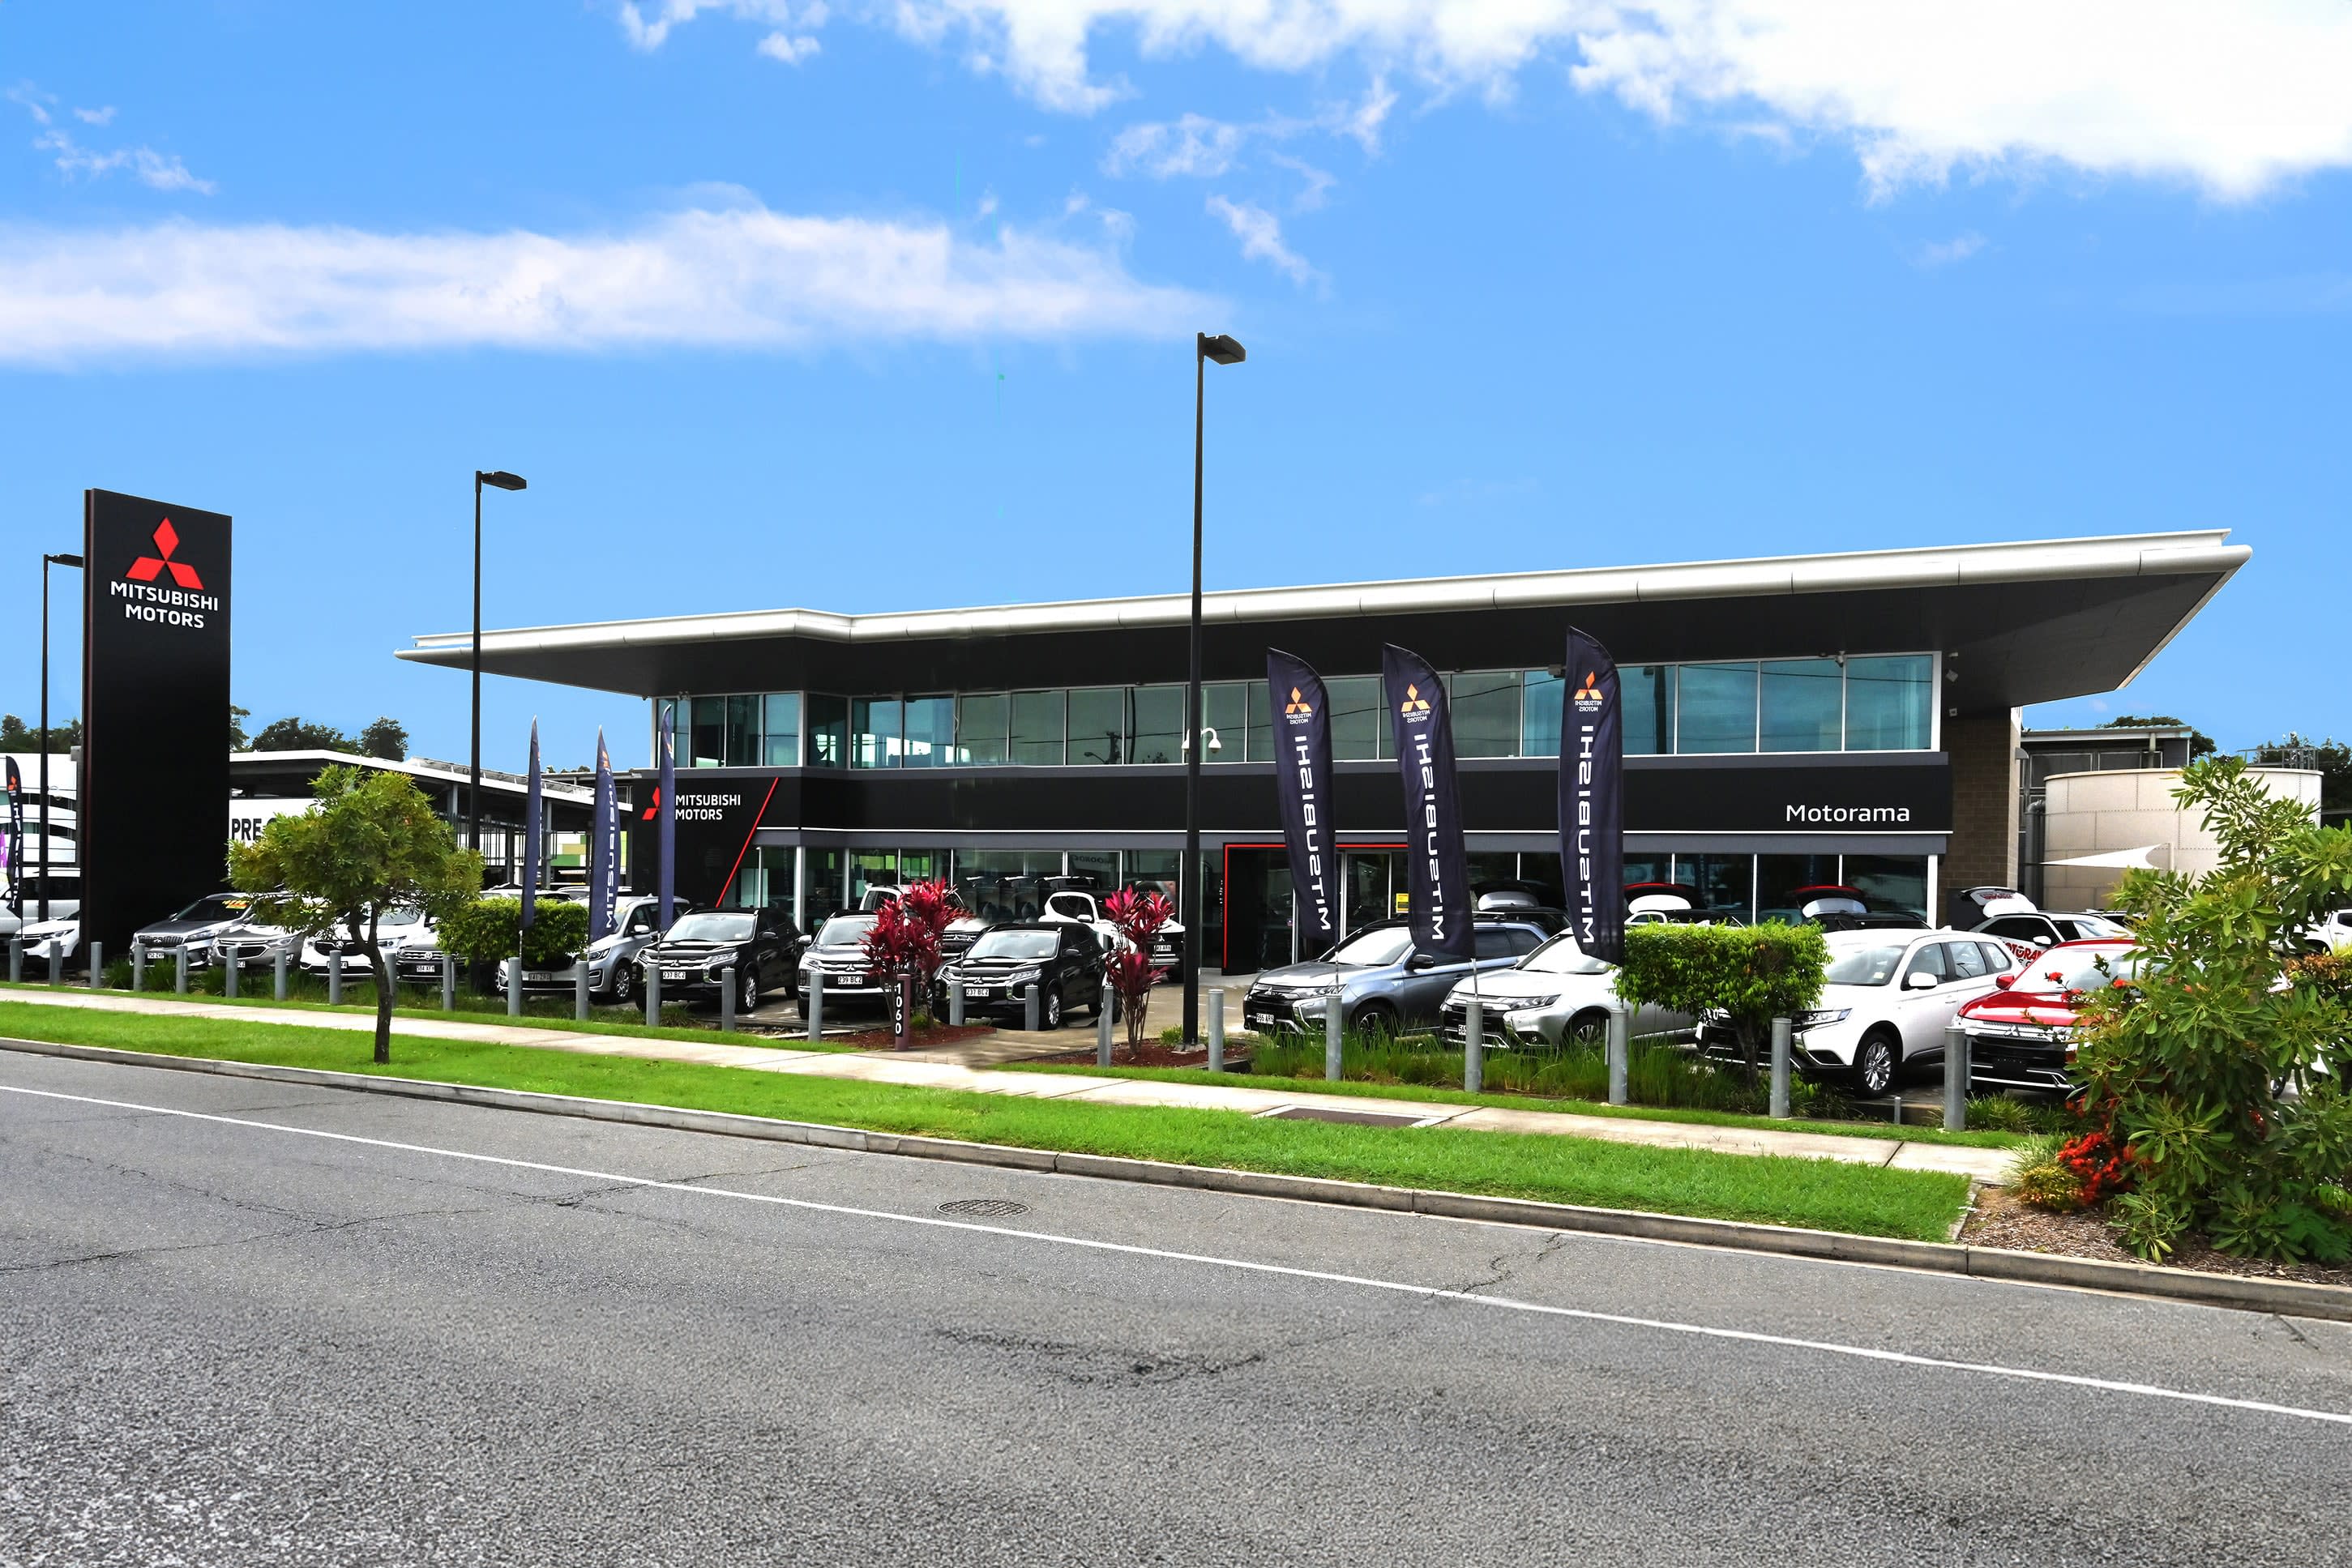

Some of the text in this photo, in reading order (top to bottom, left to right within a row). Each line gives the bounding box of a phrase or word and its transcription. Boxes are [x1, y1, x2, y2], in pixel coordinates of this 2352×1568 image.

[110, 581, 218, 611] MITSUBISHI
[126, 604, 204, 628] MOTORS
[675, 794, 741, 806] MITSUBISHI
[675, 809, 723, 820] MOTORS
[1786, 805, 1910, 822] Motorama
[231, 818, 262, 841] PRE
[895, 982, 904, 1035] 1060
